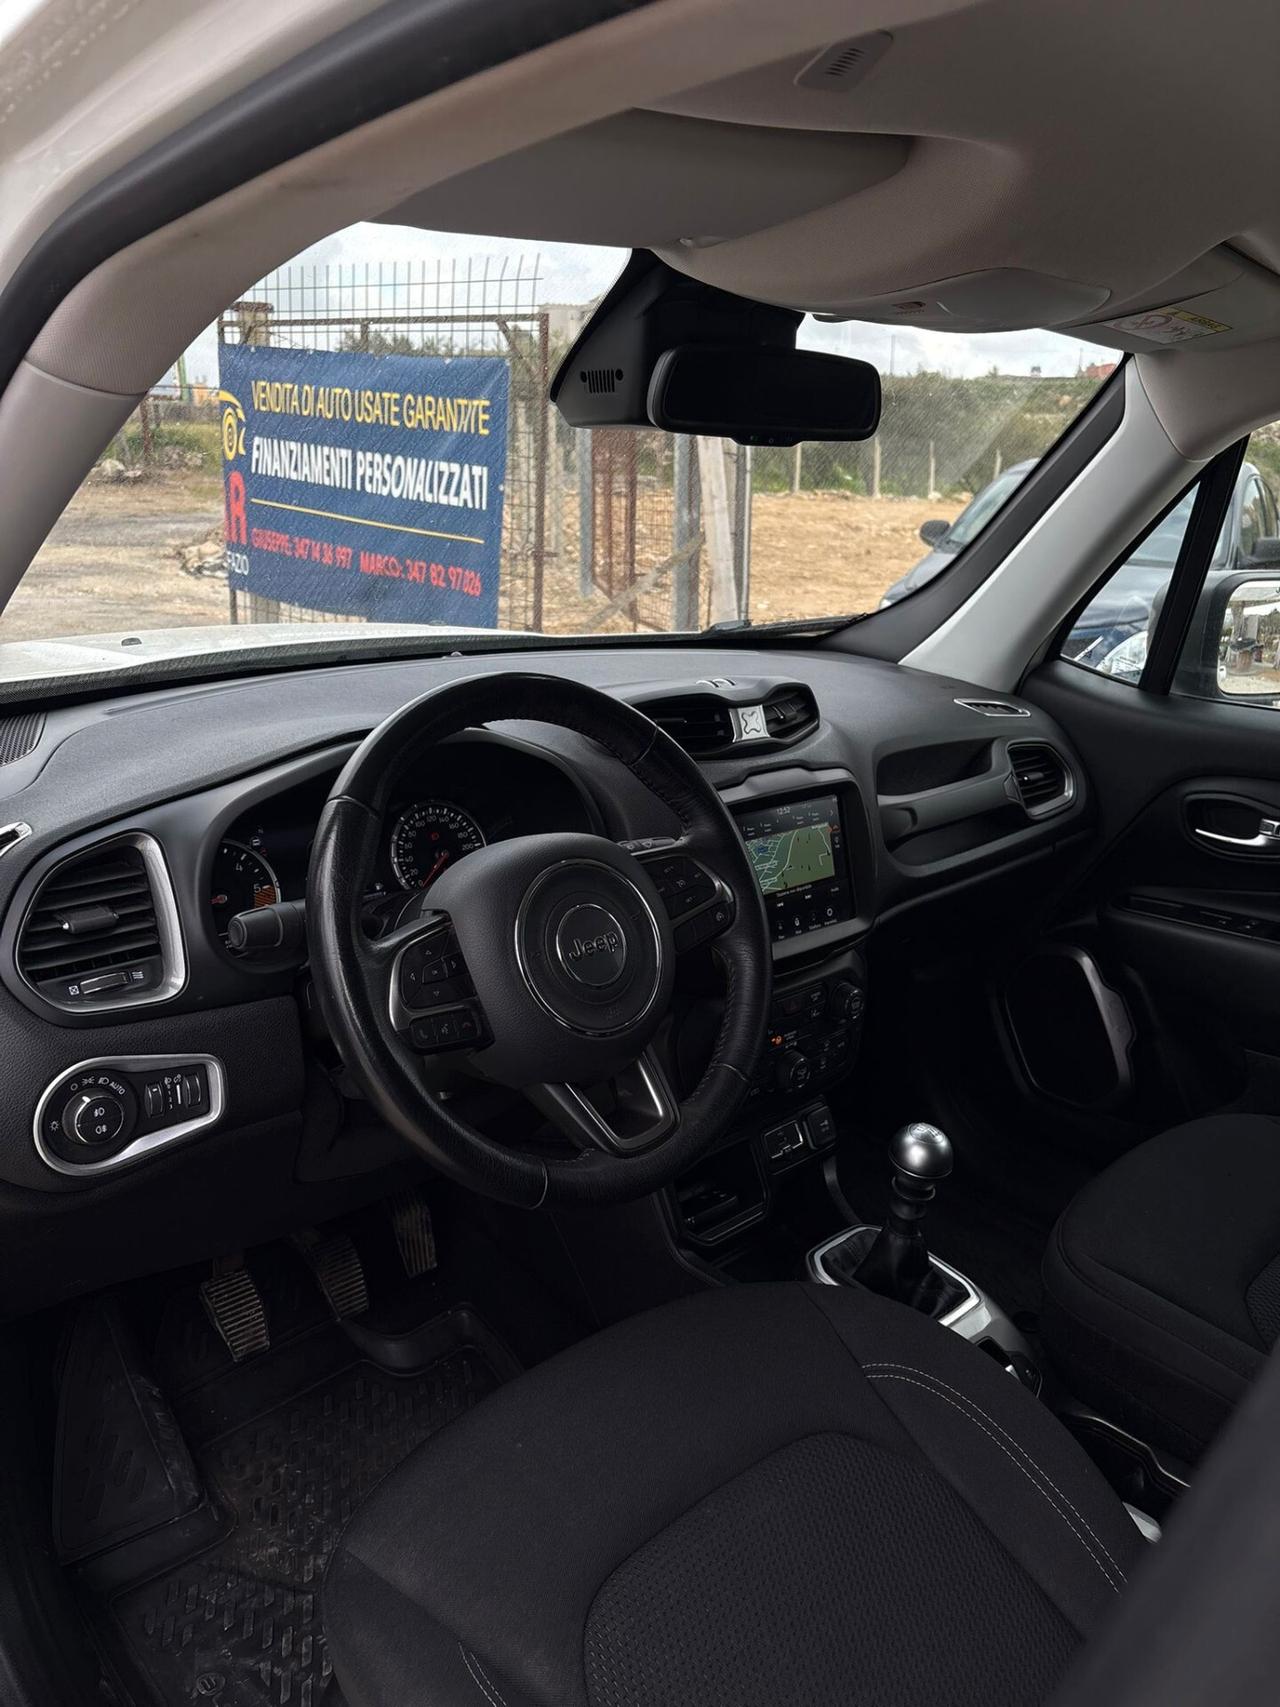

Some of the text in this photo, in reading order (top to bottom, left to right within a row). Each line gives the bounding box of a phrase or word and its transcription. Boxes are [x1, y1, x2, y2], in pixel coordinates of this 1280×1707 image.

[251, 380, 490, 436] VENDITA DI AUTO USATE GARANTITE
[251, 436, 488, 511] FINANZIAMENTI PERSONALIZZATI
[405, 559, 427, 583] 347
[429, 562, 447, 588] 82
[568, 931, 618, 960] Jeep
[109, 1081, 126, 1096] AUTO
